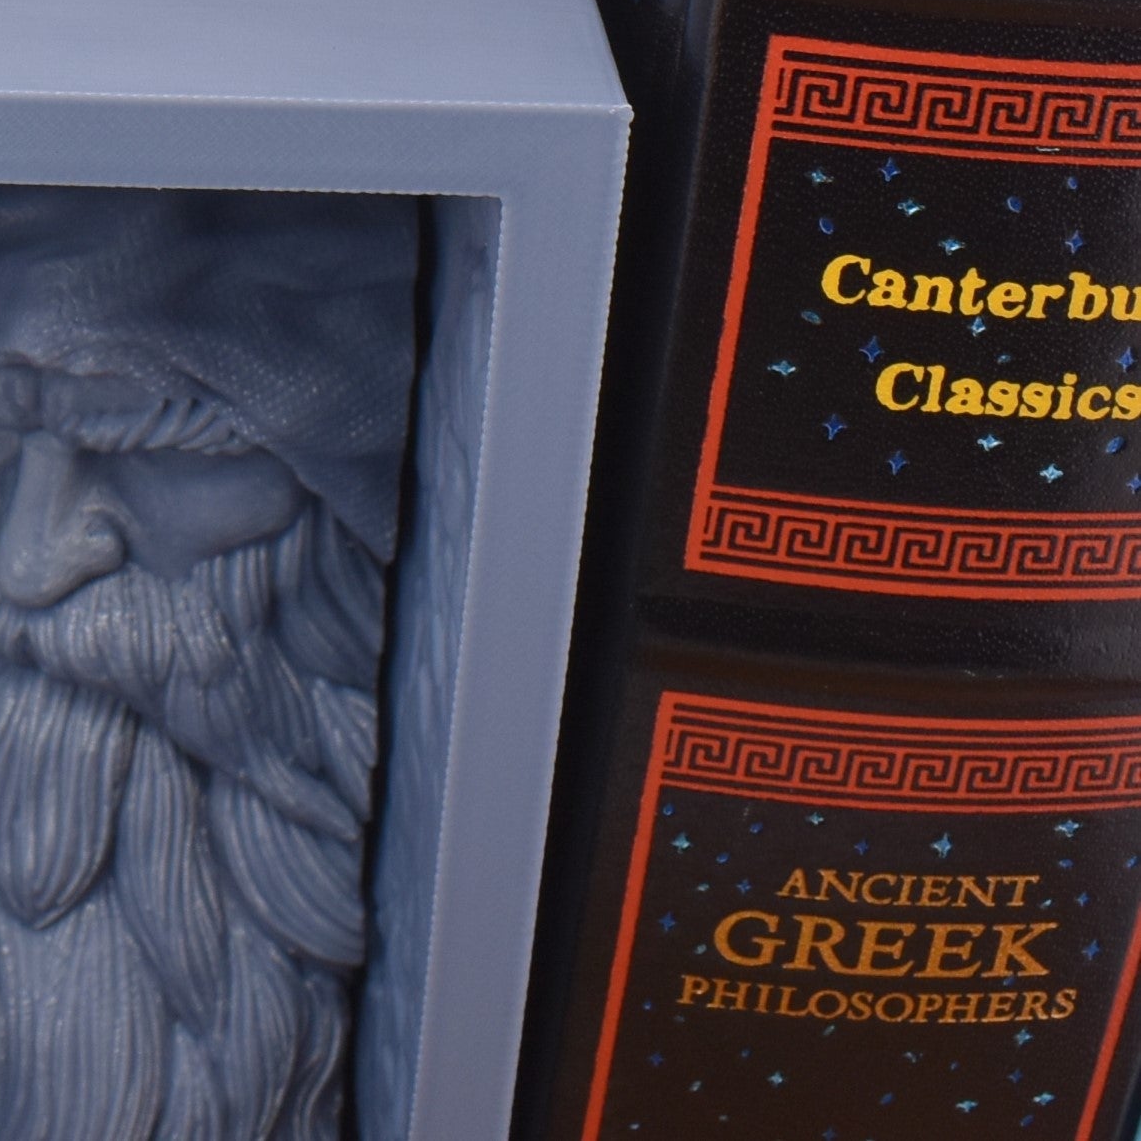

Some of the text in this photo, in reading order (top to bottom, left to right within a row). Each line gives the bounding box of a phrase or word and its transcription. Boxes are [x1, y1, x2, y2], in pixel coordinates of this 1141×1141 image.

[820, 254, 1141, 322] Canterbu
[875, 362, 1141, 421] Classics
[776, 868, 1040, 907] ANCIENT
[713, 910, 1059, 979] GREEK
[675, 975, 1078, 1025] PHILOSOPHERS
